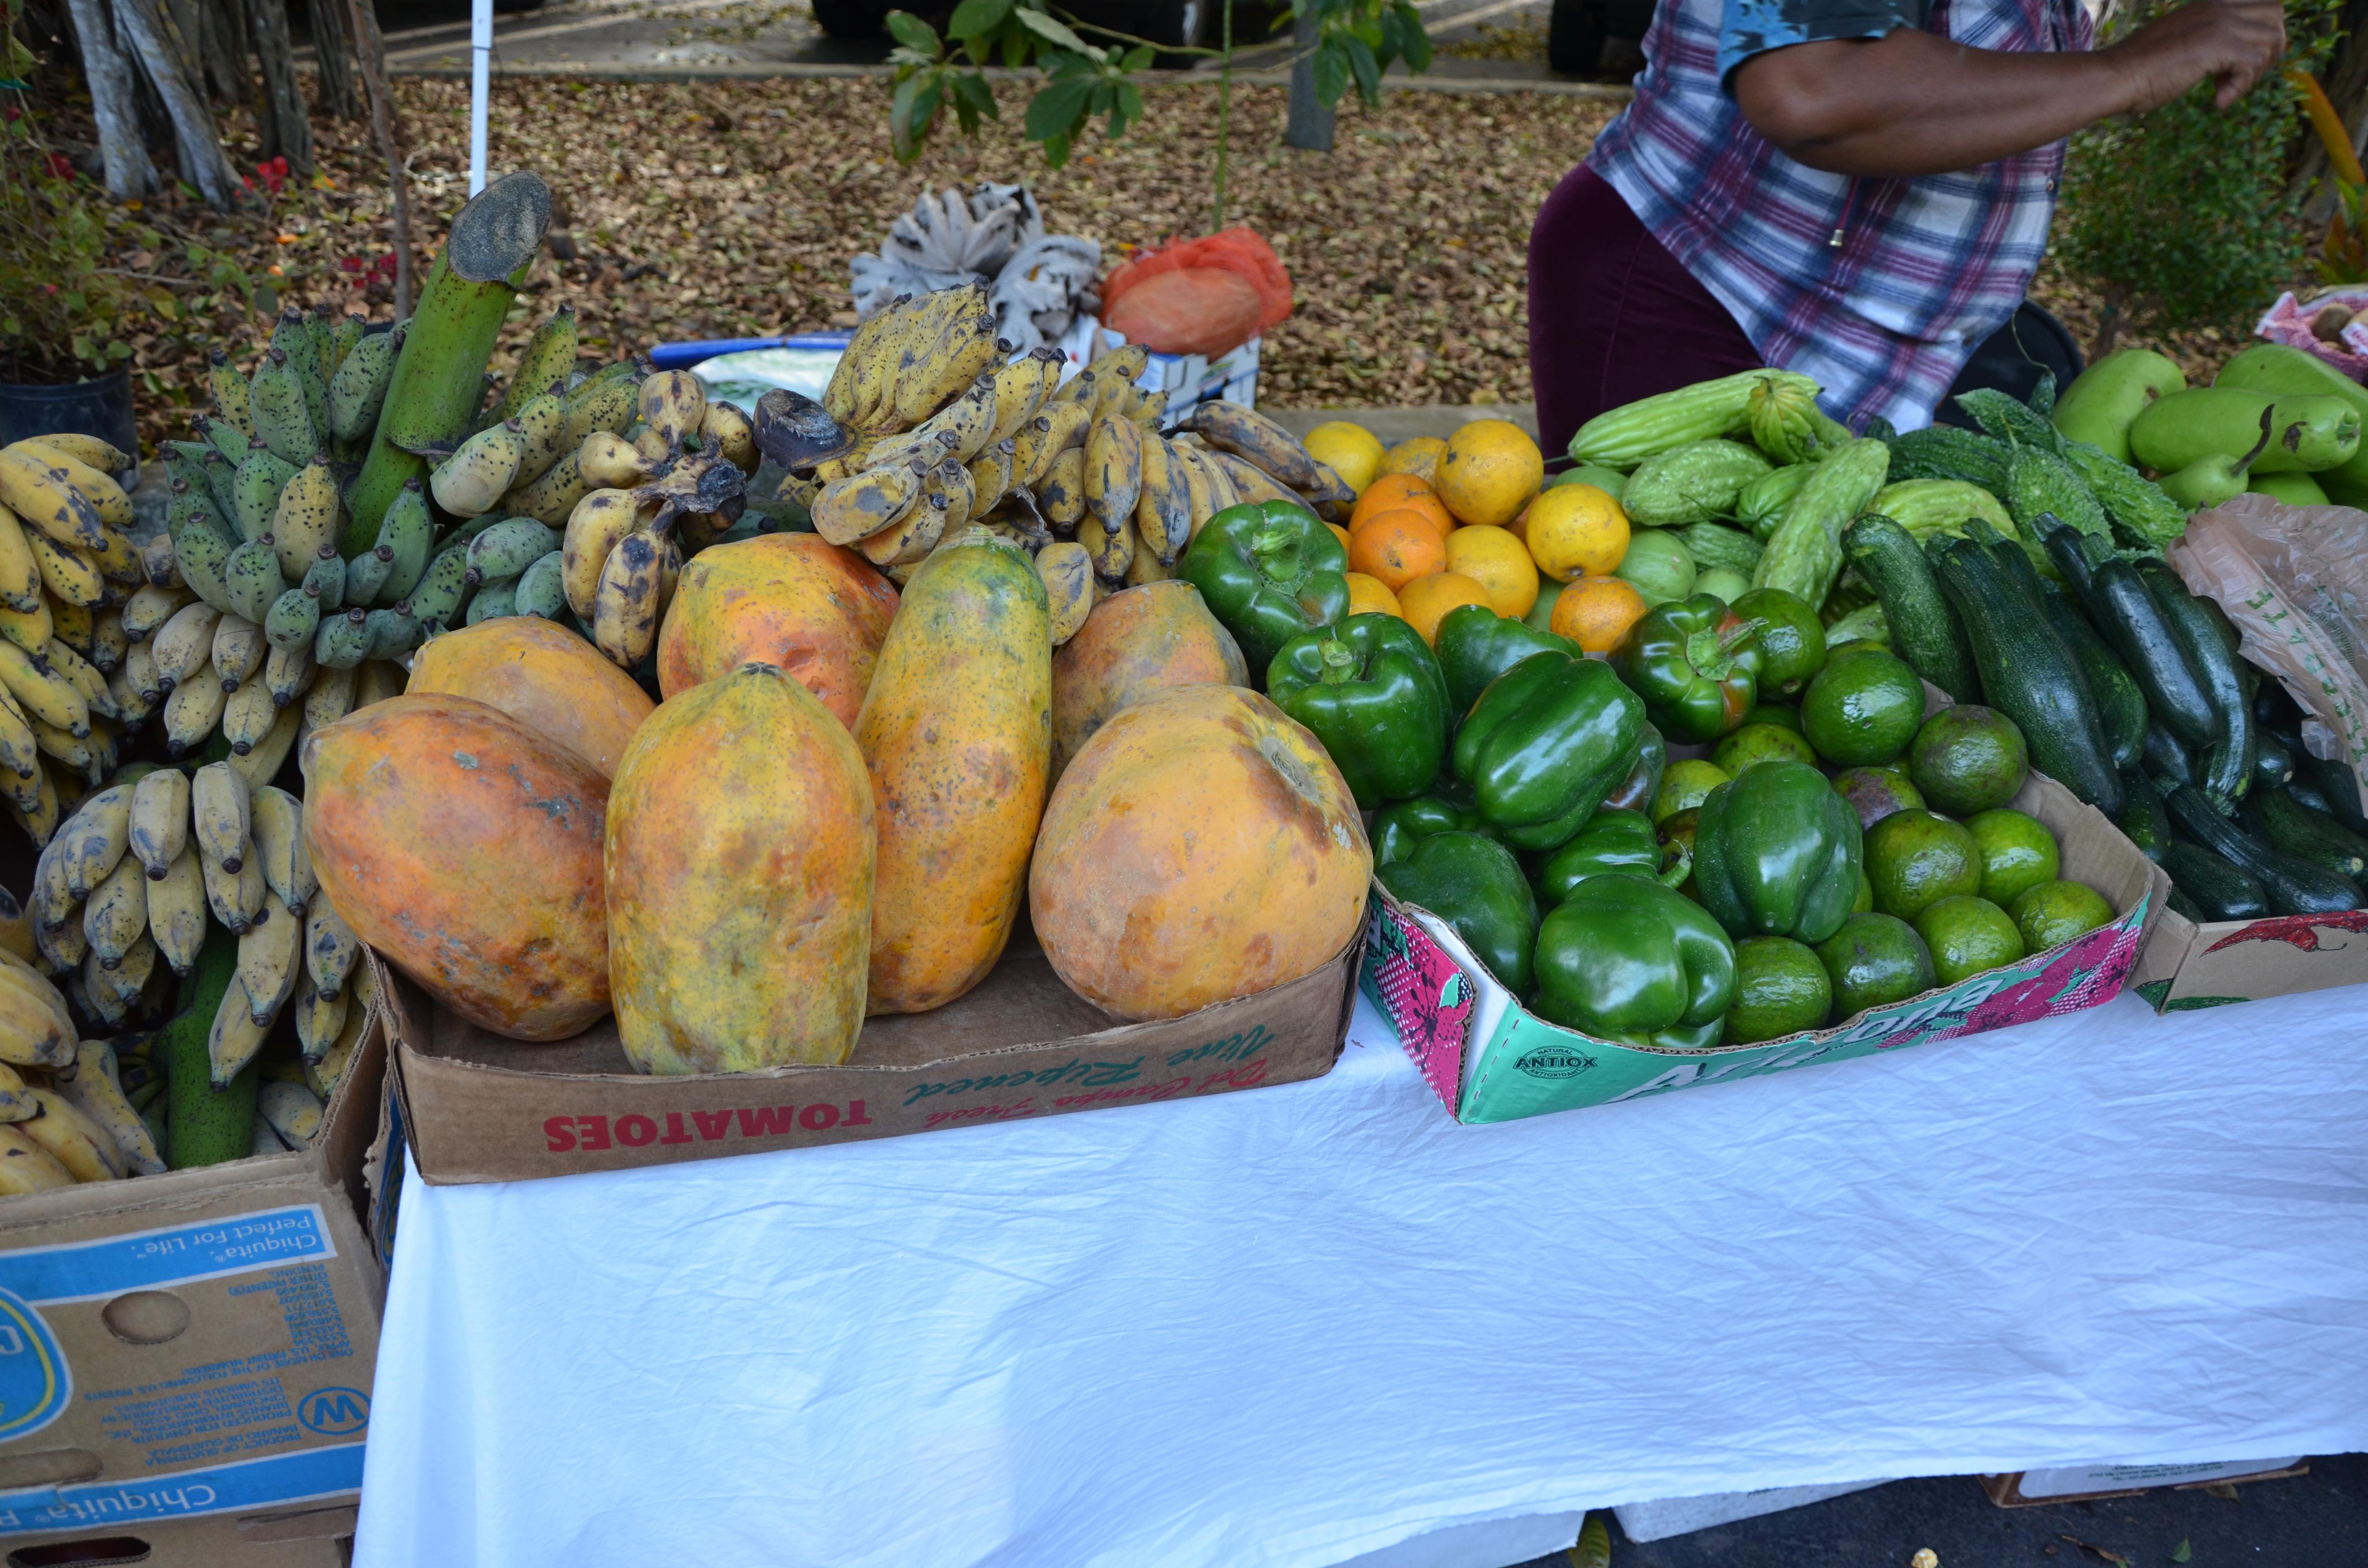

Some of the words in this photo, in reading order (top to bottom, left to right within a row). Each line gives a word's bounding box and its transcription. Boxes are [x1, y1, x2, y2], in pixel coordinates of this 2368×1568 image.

[1166, 1024, 1275, 1066] Vine
[1513, 1056, 1598, 1069] ANTIOX
[1196, 1059, 1267, 1091] Del
[1529, 1068, 1581, 1077] ANTIOXIDANT
[902, 1056, 1147, 1106] Ripened
[1053, 1077, 1192, 1107] Campo
[923, 1097, 1036, 1128] Fresh
[543, 1100, 872, 1152] TOMATOES
[233, 1215, 311, 1239] Perfect
[190, 1230, 227, 1247] For
[289, 1271, 328, 1285] OTHER
[245, 1350, 287, 1364] PATENT
[308, 1352, 326, 1362] OR
[329, 1348, 354, 1359] ONE
[254, 1362, 271, 1372] OF
[273, 1356, 308, 1368] MORE
[230, 1366, 252, 1376] THE
[221, 1409, 293, 1427] PRODUCED
[314, 1394, 366, 1426] W
[193, 1422, 220, 1433] FOR
[130, 1428, 192, 1444] CHIQUITA
[225, 1434, 244, 1443] DE
[243, 1433, 301, 1449] PRODUCT
[146, 1438, 224, 1458] GUATEMALA
[222, 1444, 239, 1453] OF
[143, 1447, 220, 1467] GUATEMALA
